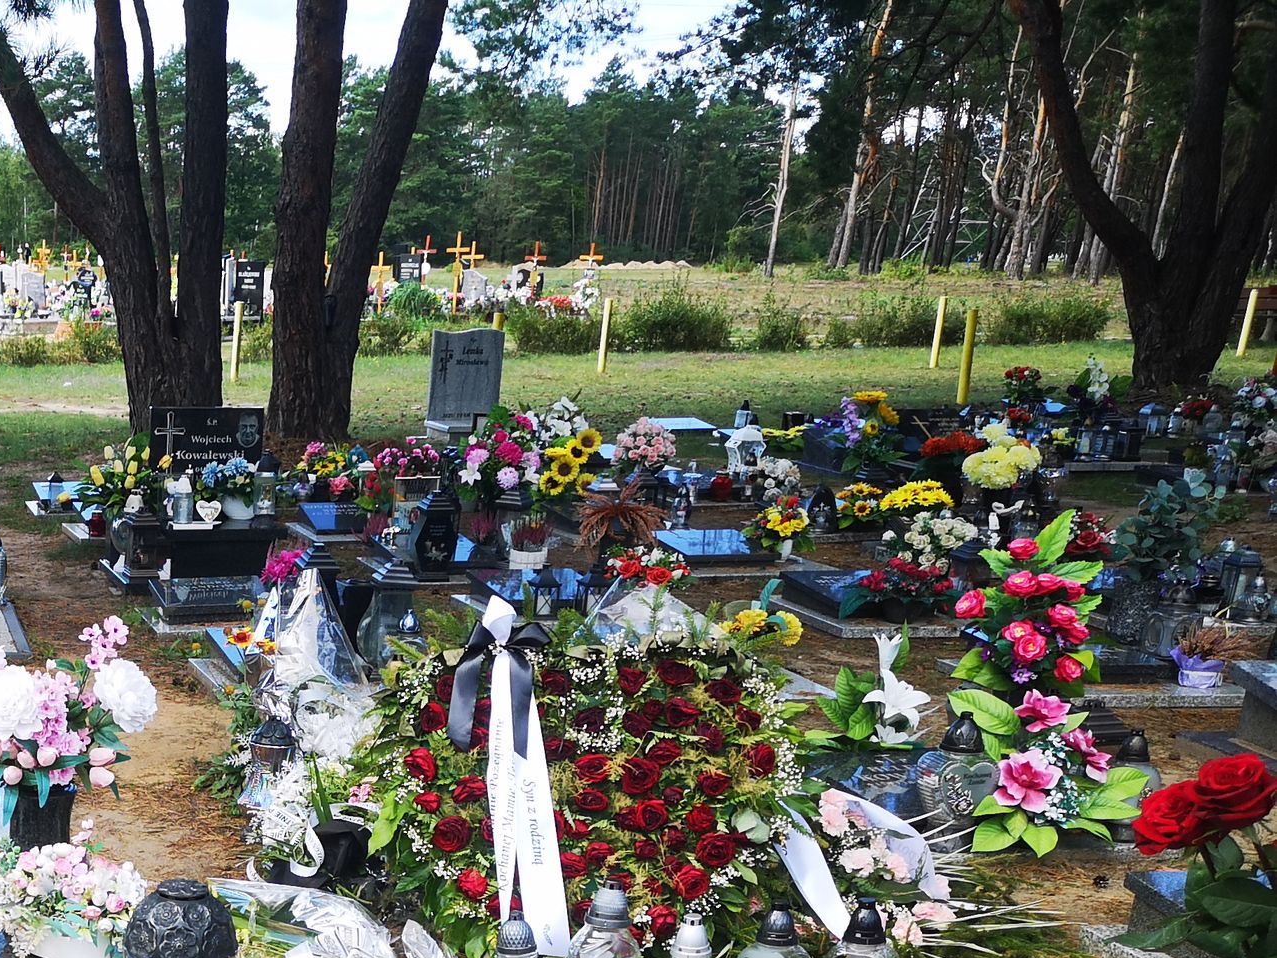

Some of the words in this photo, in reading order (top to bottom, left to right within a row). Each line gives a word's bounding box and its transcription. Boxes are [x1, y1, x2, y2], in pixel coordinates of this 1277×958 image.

[191, 435, 232, 445] Wojciech
[176, 450, 245, 460] Kowalewski
[521, 779, 536, 802] Syn
[528, 818, 545, 865] rodziną
